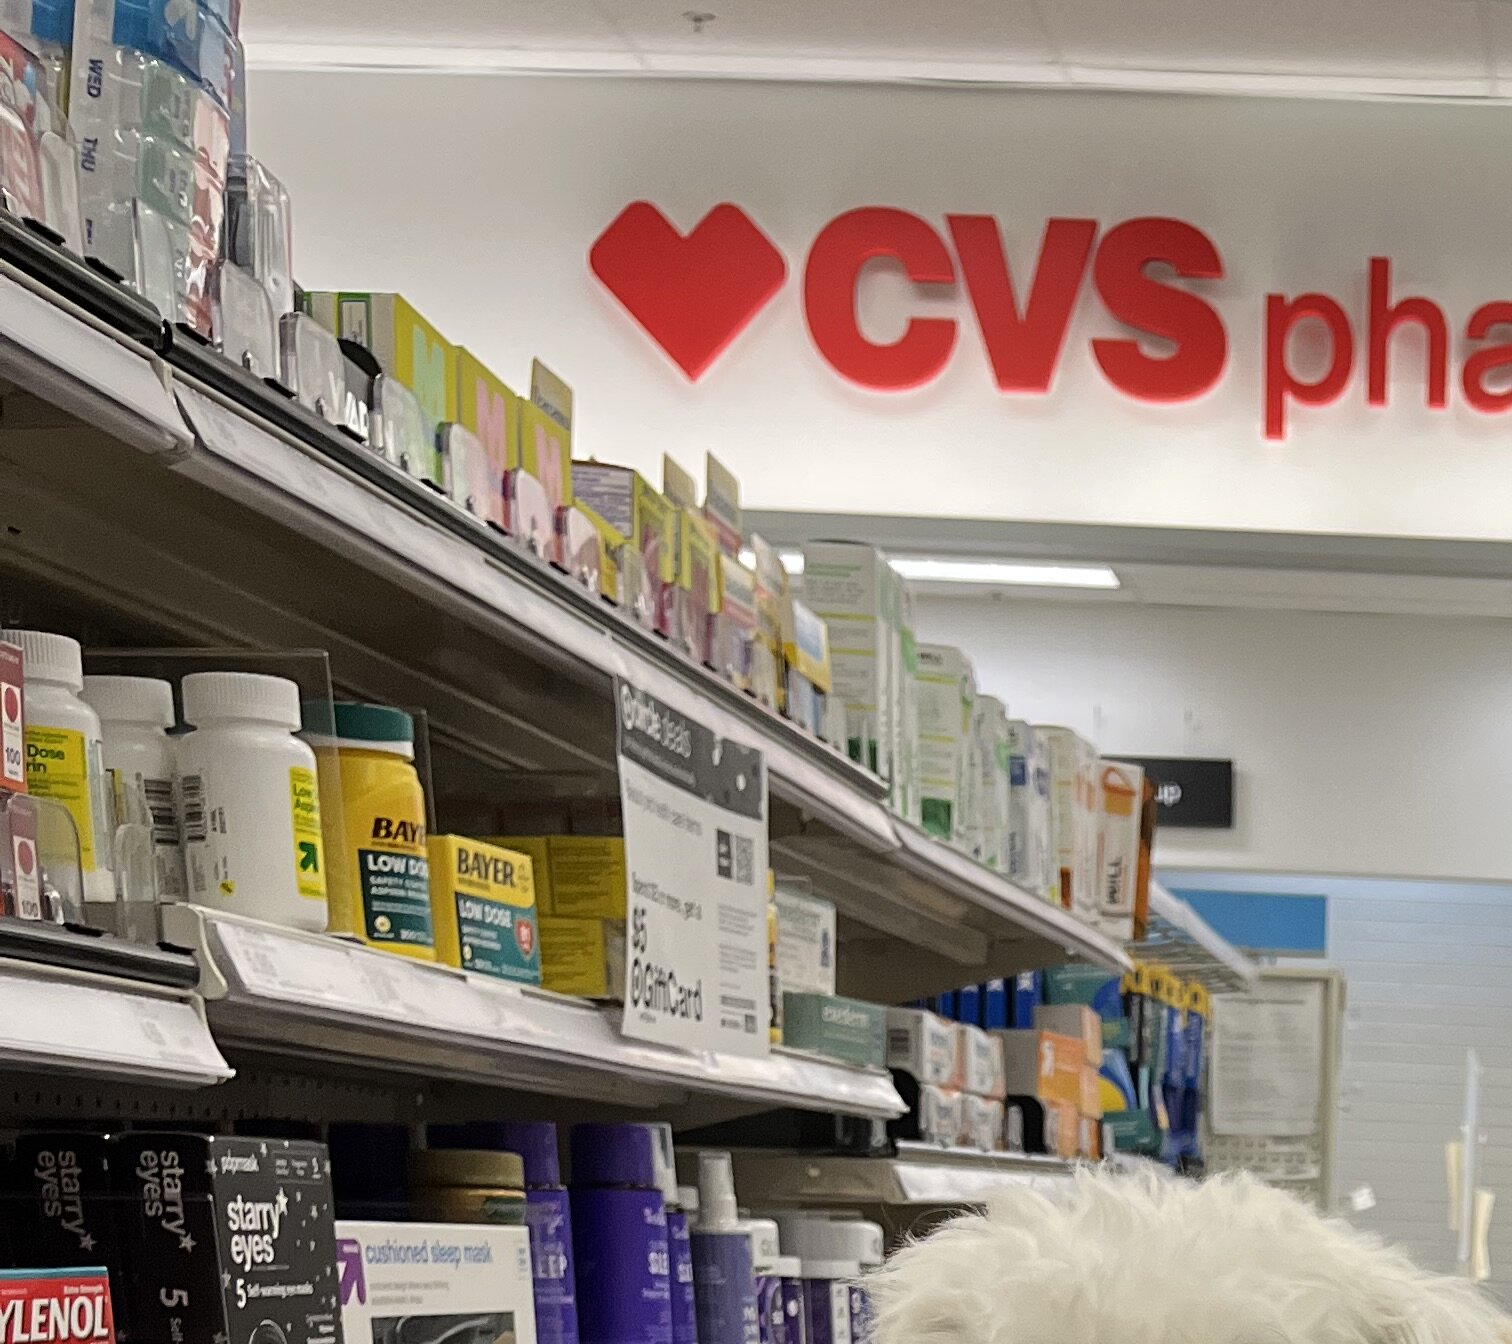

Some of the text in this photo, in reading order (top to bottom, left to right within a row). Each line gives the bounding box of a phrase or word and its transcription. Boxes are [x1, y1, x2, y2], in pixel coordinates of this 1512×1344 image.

[86, 59, 103, 98] WED
[81, 137, 98, 172] THU
[802, 206, 1228, 401] CVS
[372, 817, 425, 846] BAY
[367, 853, 428, 878] LOW DO
[457, 847, 516, 888] BAYER
[458, 899, 512, 929] LOW DOSE
[34, 1150, 62, 1217] eyes
[58, 1150, 87, 1236] starry
[136, 1150, 164, 1217] eyes
[160, 1150, 187, 1236] starry
[227, 1193, 280, 1239] starry
[230, 1233, 275, 1273] eyes
[365, 1239, 495, 1271] cushioned sleep mask
[160, 1286, 188, 1308] 5
[0, 1295, 109, 1344] YLENOL
